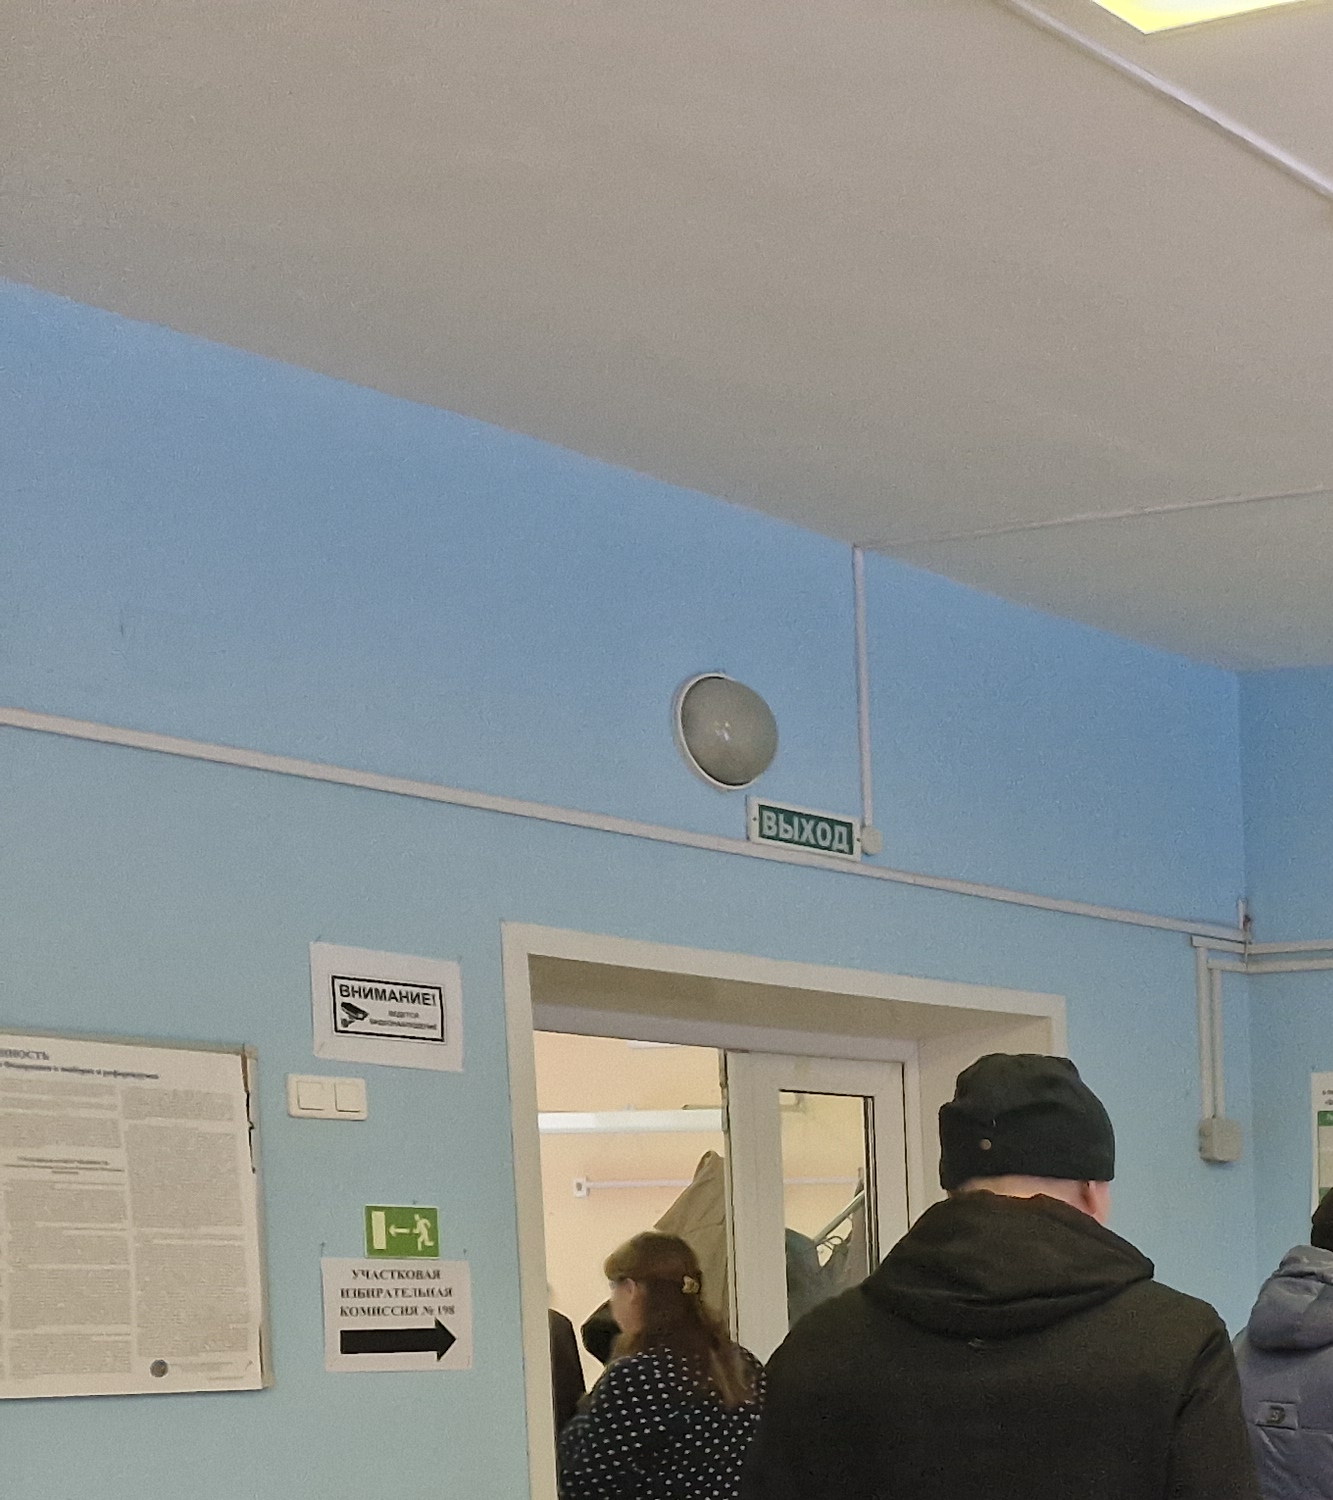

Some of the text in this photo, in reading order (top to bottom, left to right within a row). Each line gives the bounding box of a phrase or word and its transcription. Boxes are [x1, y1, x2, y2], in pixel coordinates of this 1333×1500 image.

[761, 810, 849, 853] ВЫХОД
[340, 984, 437, 1006] ВНИМАНИЕ!
[351, 1269, 440, 1280] УЧАСТКОВАЯ
[340, 1287, 453, 1299] ИЗБИРАТЕЛЬНАЯ
[340, 1305, 418, 1317] КОМИССИЯ
